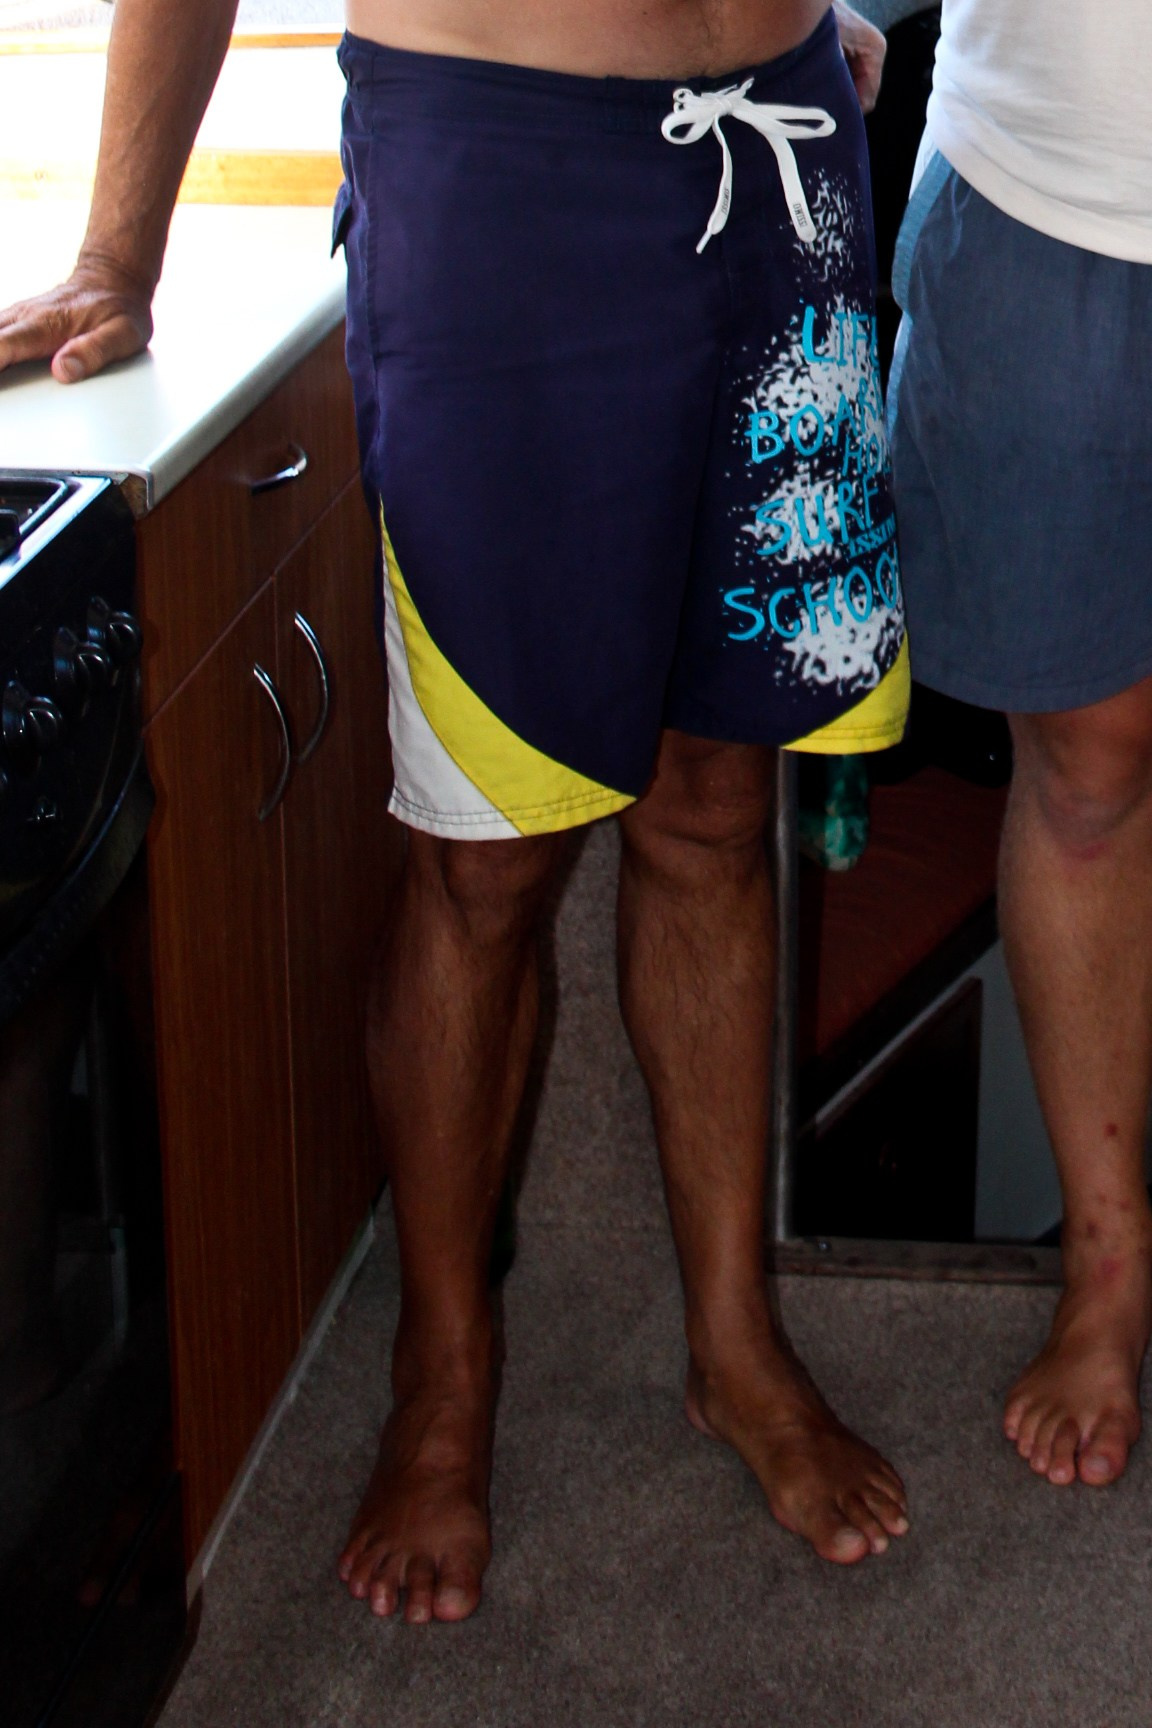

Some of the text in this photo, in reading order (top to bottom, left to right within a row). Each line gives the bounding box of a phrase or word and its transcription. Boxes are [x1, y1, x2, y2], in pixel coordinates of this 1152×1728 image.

[842, 432, 891, 476] HO
[755, 472, 879, 556] SURF
[723, 540, 900, 642] SCHOO
